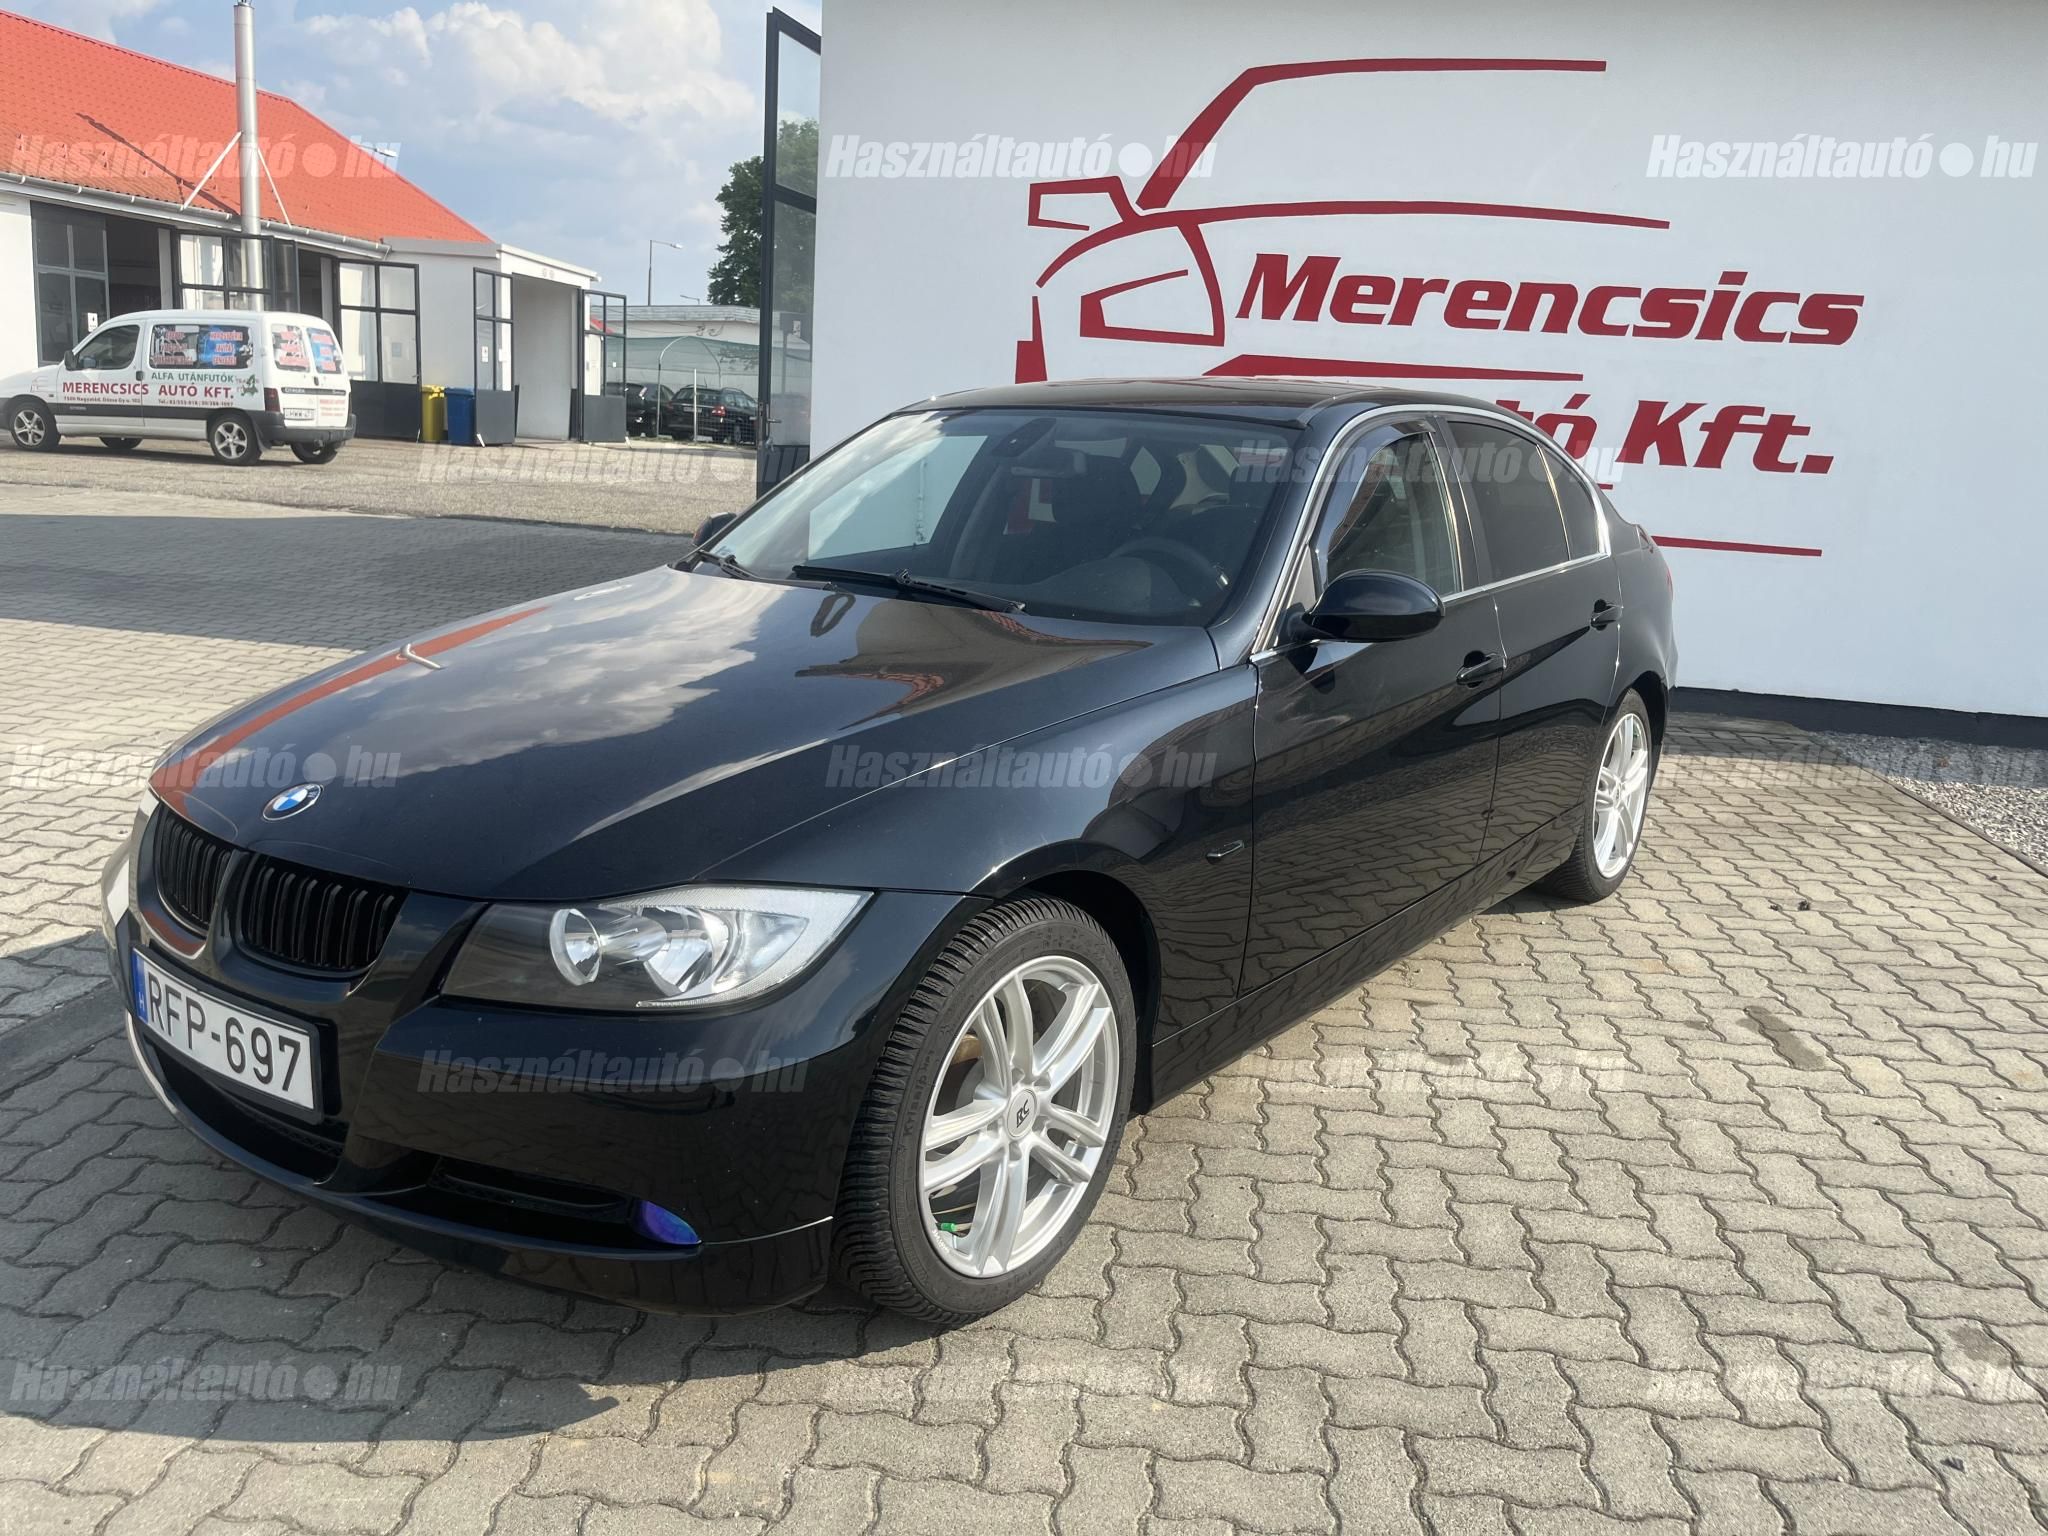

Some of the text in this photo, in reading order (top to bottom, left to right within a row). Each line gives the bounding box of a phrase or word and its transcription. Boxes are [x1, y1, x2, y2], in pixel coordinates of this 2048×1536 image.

[1235, 253, 1865, 345] Merencsics
[62, 382, 234, 399] MERENCSICS AUTÓ KFT.
[151, 371, 234, 383] ALFA UTÁNFUTÓK
[1616, 399, 1834, 474] Kft.
[148, 971, 301, 1092] RFP-697
